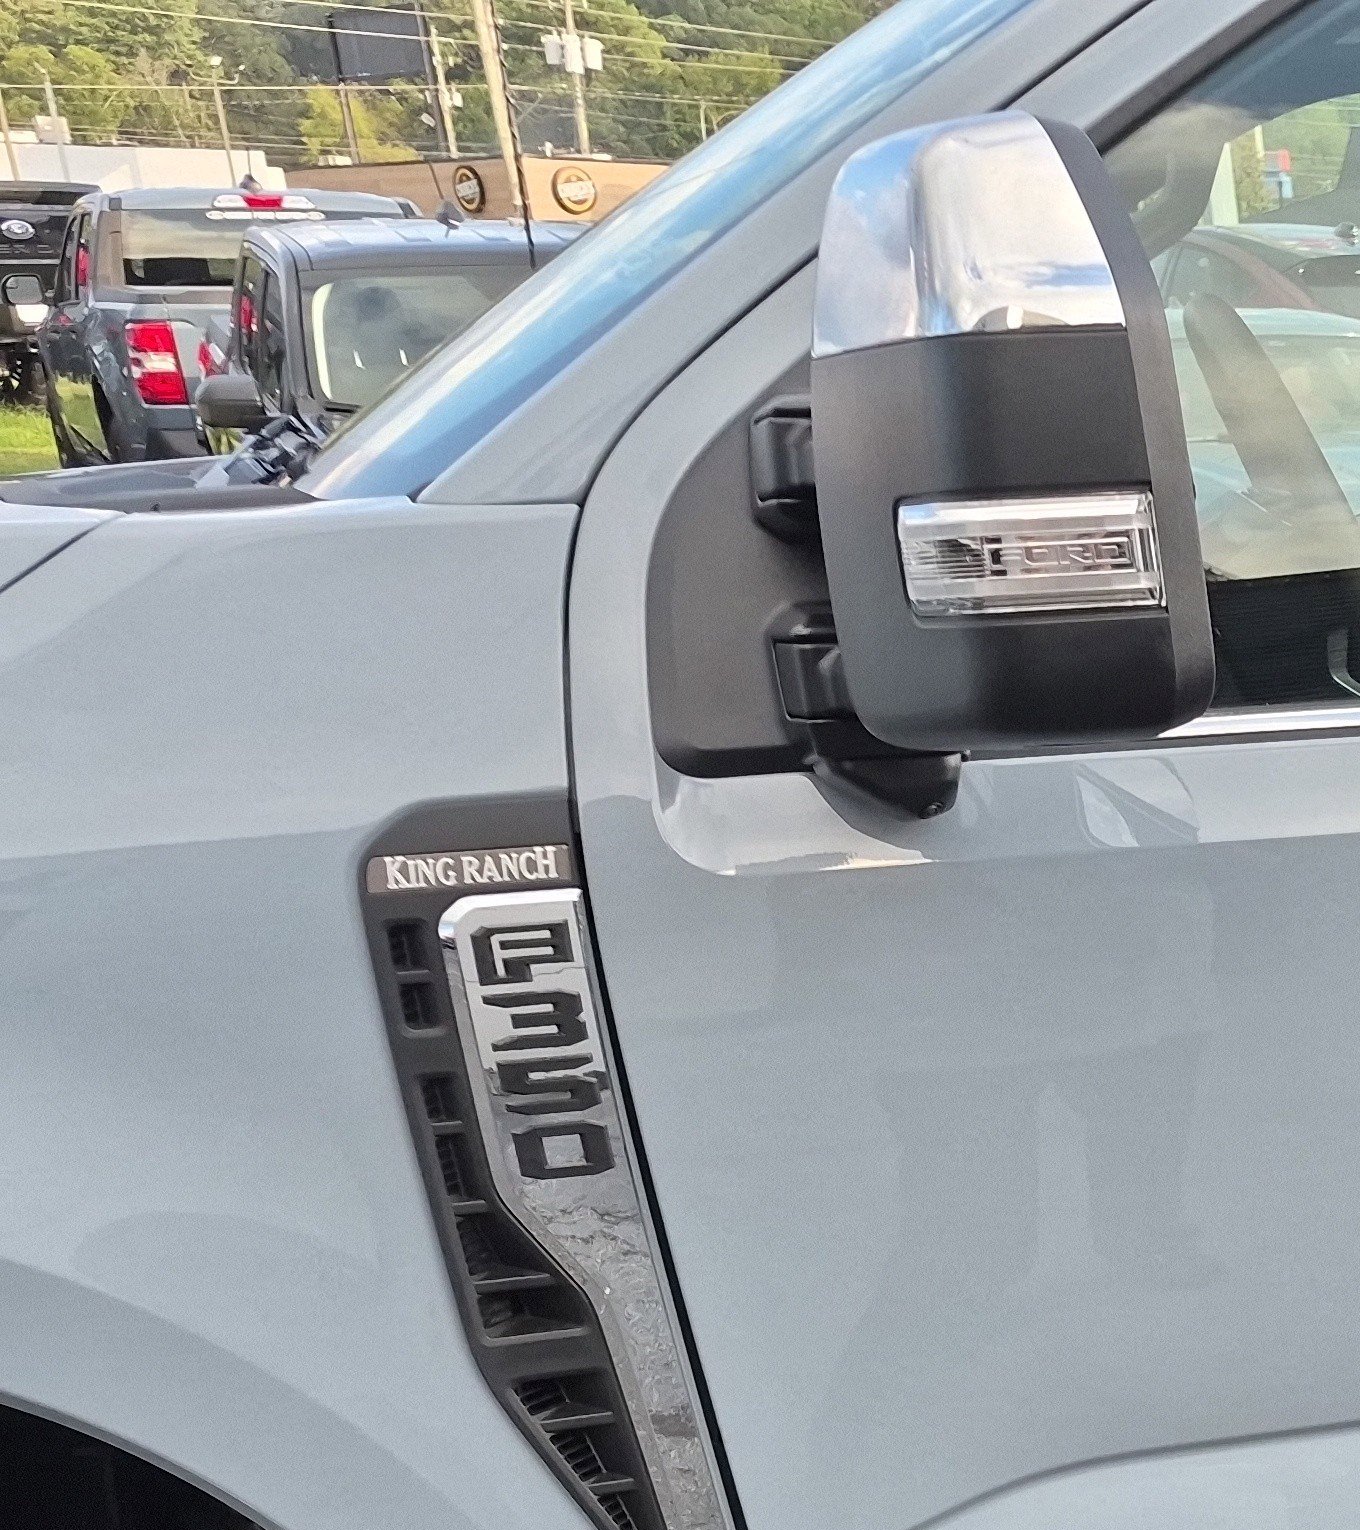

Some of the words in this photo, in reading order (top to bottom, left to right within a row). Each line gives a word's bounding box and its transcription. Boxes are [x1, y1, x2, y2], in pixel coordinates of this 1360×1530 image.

[990, 538, 1132, 569] FORD
[383, 855, 457, 890] KING
[461, 845, 559, 885] RANCH
